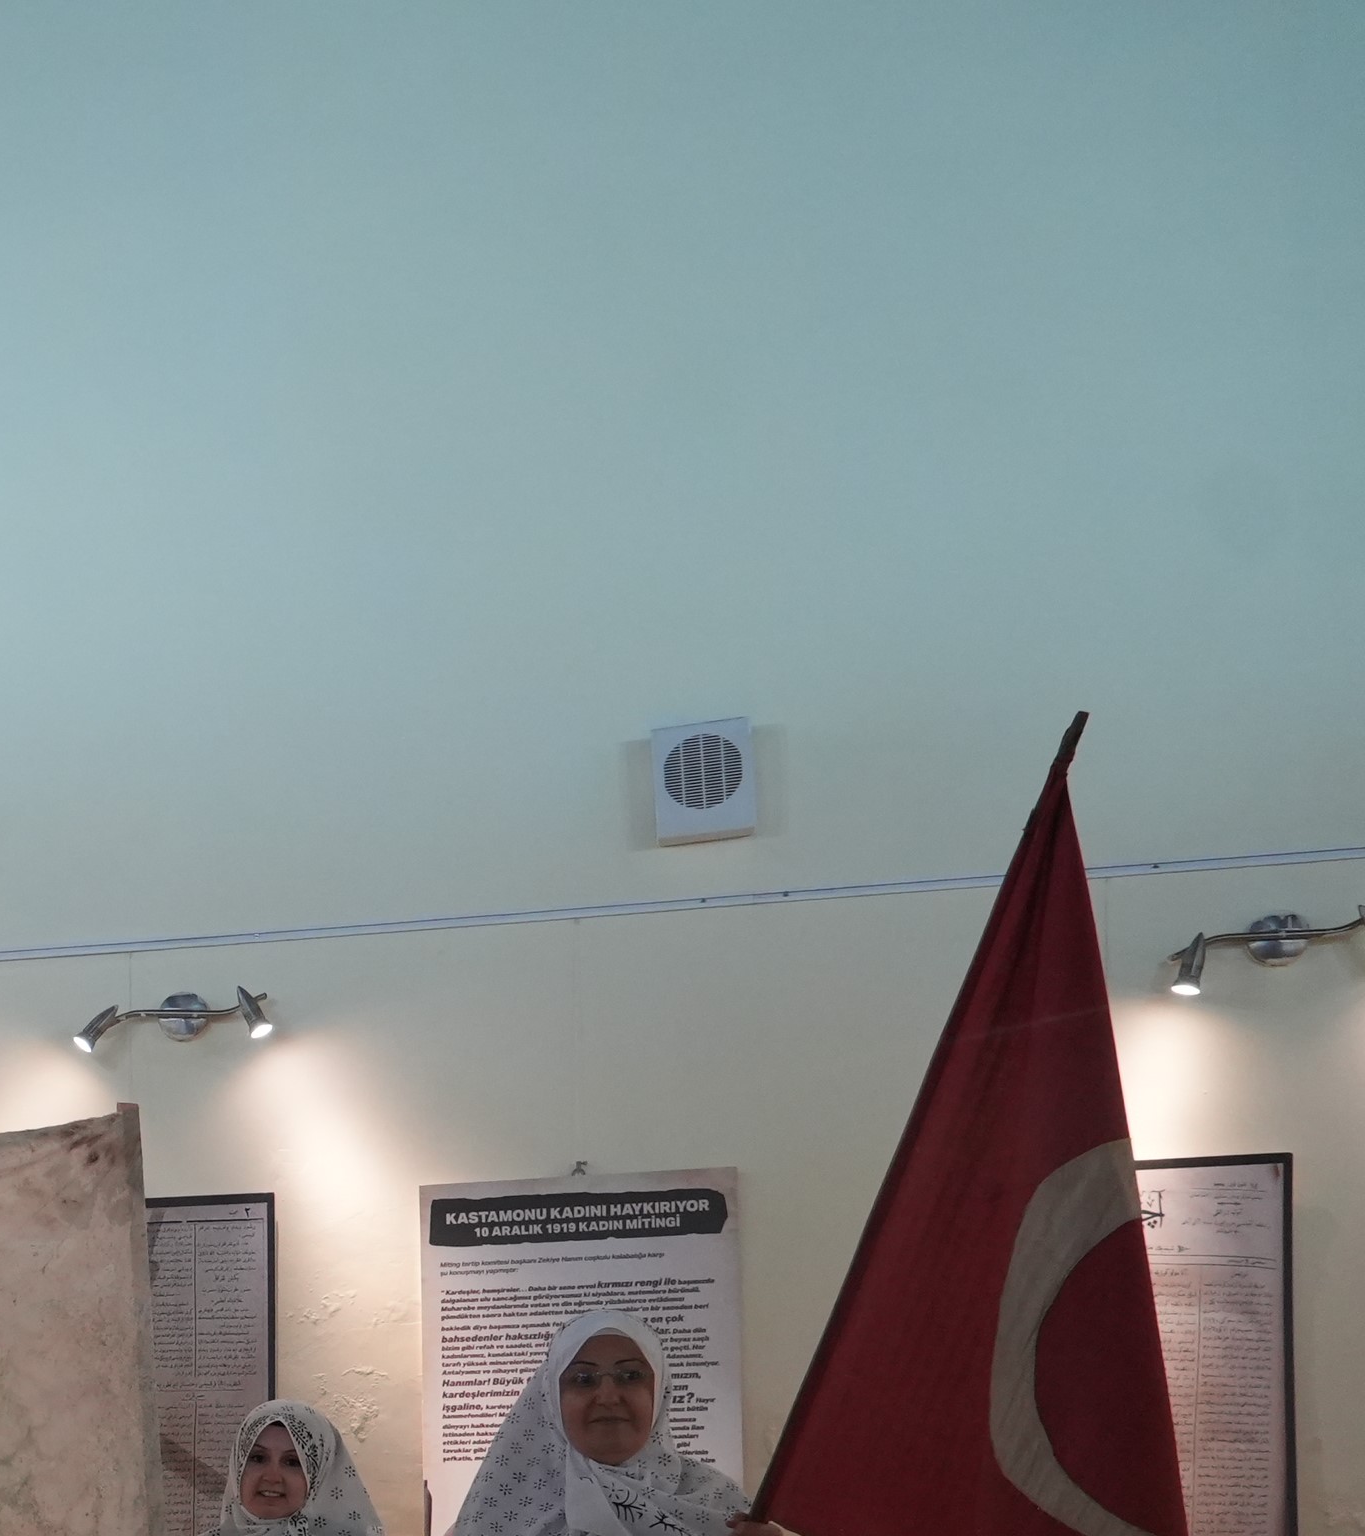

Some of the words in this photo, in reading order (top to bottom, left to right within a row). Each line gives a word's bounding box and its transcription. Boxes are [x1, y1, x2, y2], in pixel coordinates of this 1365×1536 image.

[445, 1207, 547, 1225] KASTAMONU
[549, 1204, 607, 1220] KADINI
[609, 1198, 710, 1217] HAYKIRIYOR
[473, 1226, 490, 1238] 10
[491, 1223, 543, 1237] ARALIK
[545, 1222, 577, 1234] 1919
[578, 1219, 624, 1233] KADIN
[625, 1213, 681, 1230] MİTİNGİ
[439, 1261, 462, 1269] Miting
[537, 1256, 561, 1264] Zekiye
[448, 1269, 485, 1277] konuşmayı
[596, 1280, 634, 1289] kırmızı
[634, 1277, 663, 1289] rengi
[663, 1277, 678, 1286] ile
[440, 1305, 476, 1313] Muharebe
[649, 1304, 662, 1312] bir
[649, 1316, 664, 1324] en
[664, 1313, 685, 1325] çok
[440, 1324, 472, 1332] bekledik
[472, 1324, 488, 1332] diye
[440, 1333, 505, 1344] bahsedenler
[460, 1344, 475, 1352] gibi
[475, 1343, 495, 1351] refah
[461, 1360, 488, 1369] yüksek
[491, 1367, 519, 1375] nihayet
[441, 1377, 492, 1388] Hanımlar!
[492, 1376, 525, 1387] Büyük
[441, 1388, 521, 1400] kardeşlerimizin
[441, 1402, 484, 1414] işgaline,
[441, 1423, 470, 1431] dünyayı
[472, 1446, 487, 1455] gibi
